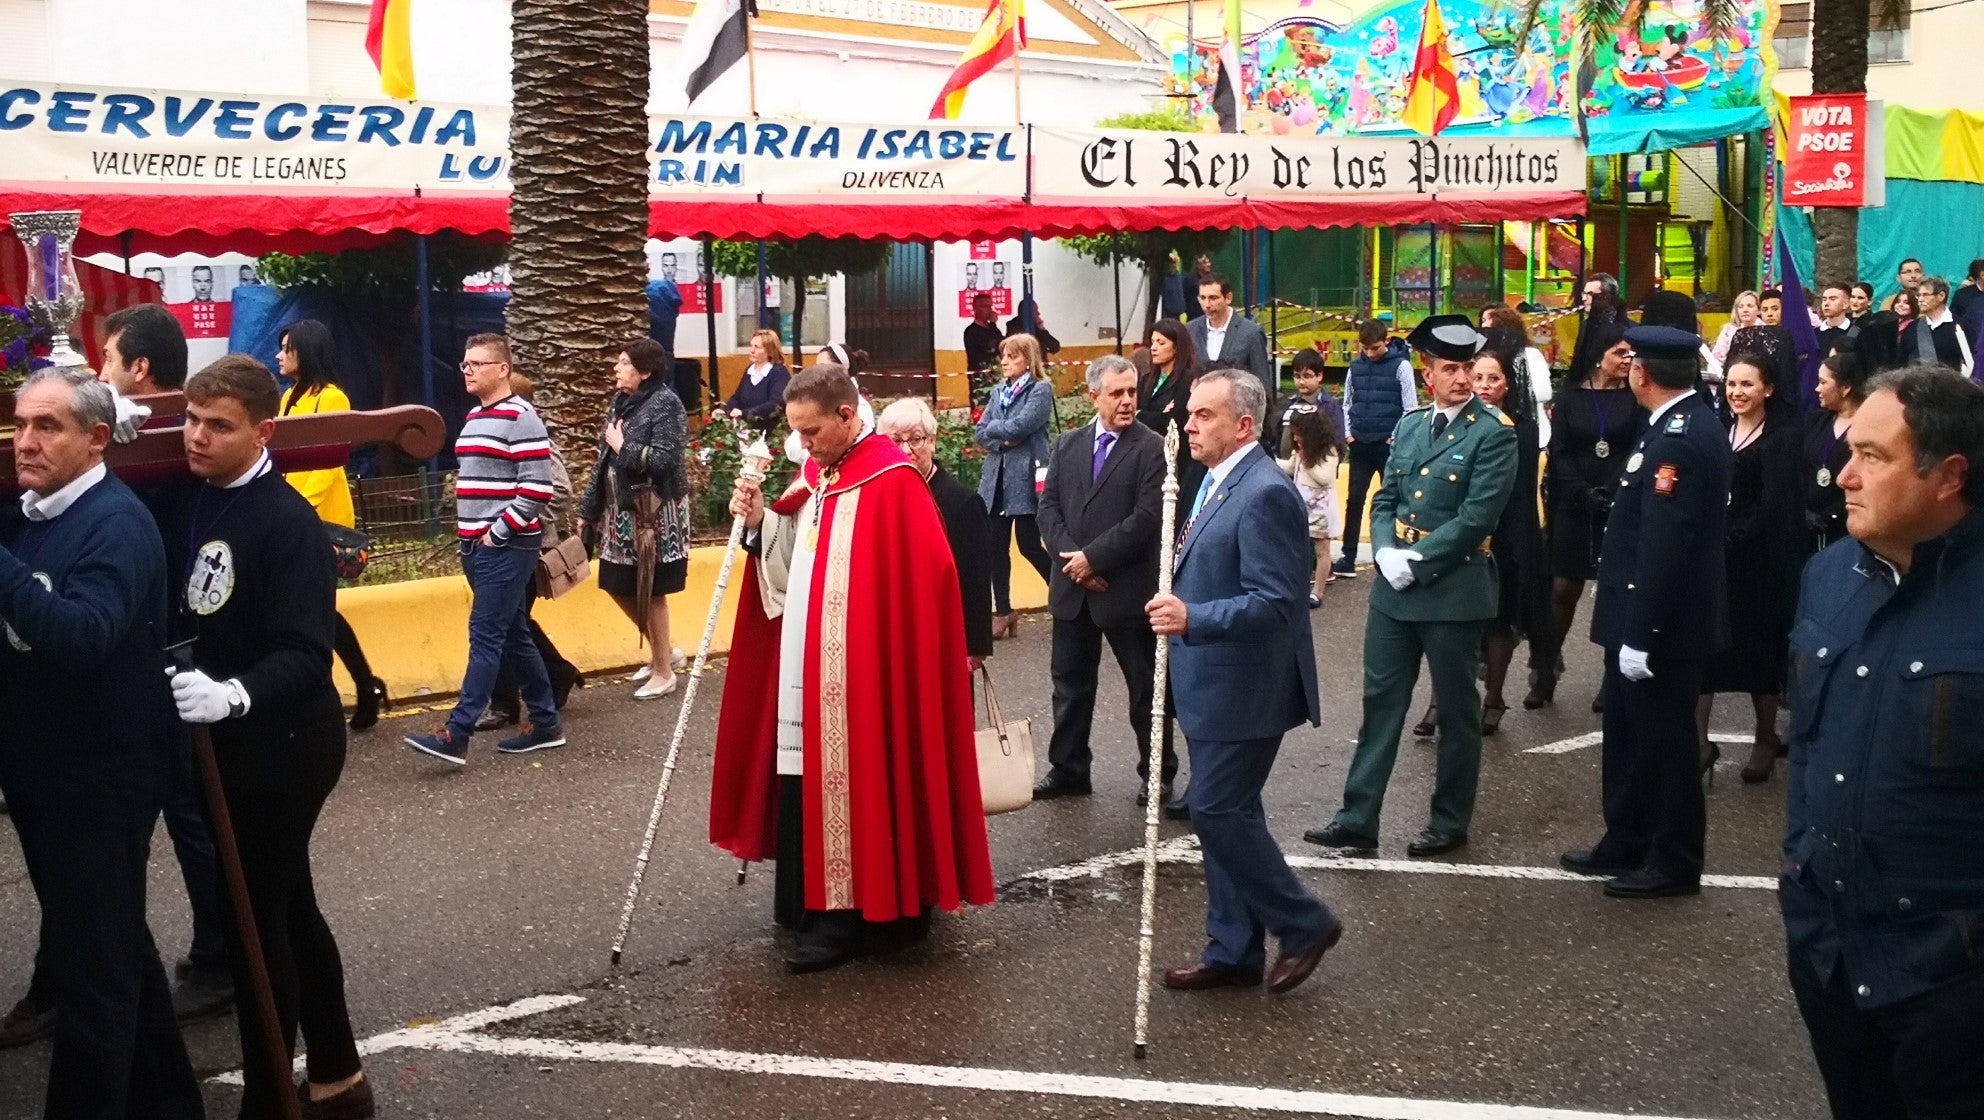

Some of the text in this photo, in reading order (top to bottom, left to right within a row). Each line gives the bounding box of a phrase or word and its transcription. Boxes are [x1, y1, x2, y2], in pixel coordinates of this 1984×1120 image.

[890, 2, 953, 27] FEBRERO
[0, 88, 477, 147] CERVECERIA
[1801, 106, 1853, 127] VOTA
[655, 119, 1018, 162] MARIA ISABEL
[1797, 131, 1854, 152] PSOE
[92, 151, 347, 180] VALVERDE DE LEGANES
[439, 153, 505, 182] LU
[842, 171, 945, 189] OLIVENZA
[1080, 136, 1560, 197] El Rey de los Pinchitos
